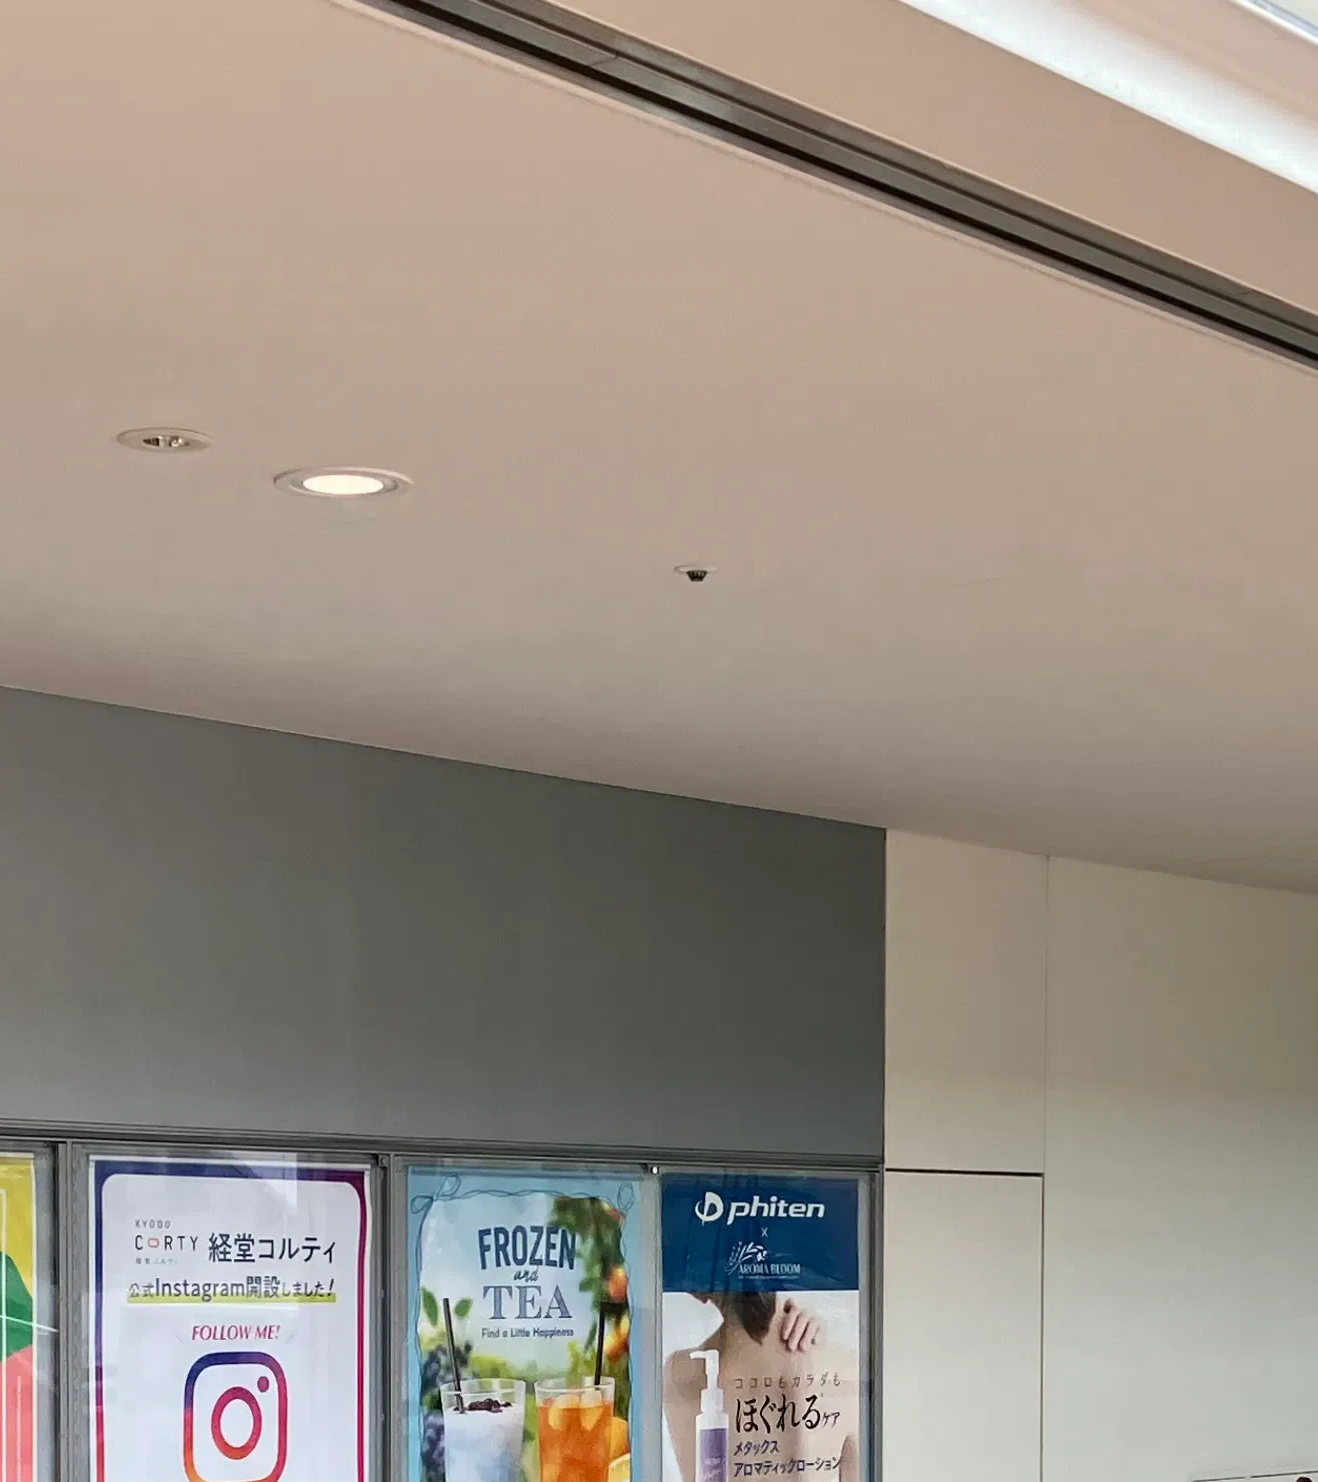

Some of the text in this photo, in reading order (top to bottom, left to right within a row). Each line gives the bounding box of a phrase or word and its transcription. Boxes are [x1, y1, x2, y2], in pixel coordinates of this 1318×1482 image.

[726, 1195, 827, 1226] phiten
[208, 1231, 337, 1263] 経堂コルティ
[478, 1224, 577, 1271] FROZEN
[513, 1267, 540, 1283] and
[128, 1276, 335, 1302] 公式Instagram開設しました!
[482, 1284, 574, 1320] TEA
[191, 1324, 281, 1341] FOLLOW ME!
[481, 1327, 501, 1340] Find
[510, 1327, 531, 1339] Little
[532, 1327, 575, 1340] Happiness
[733, 1439, 780, 1457] メタックス
[733, 1456, 841, 1478] アロマティックローション
